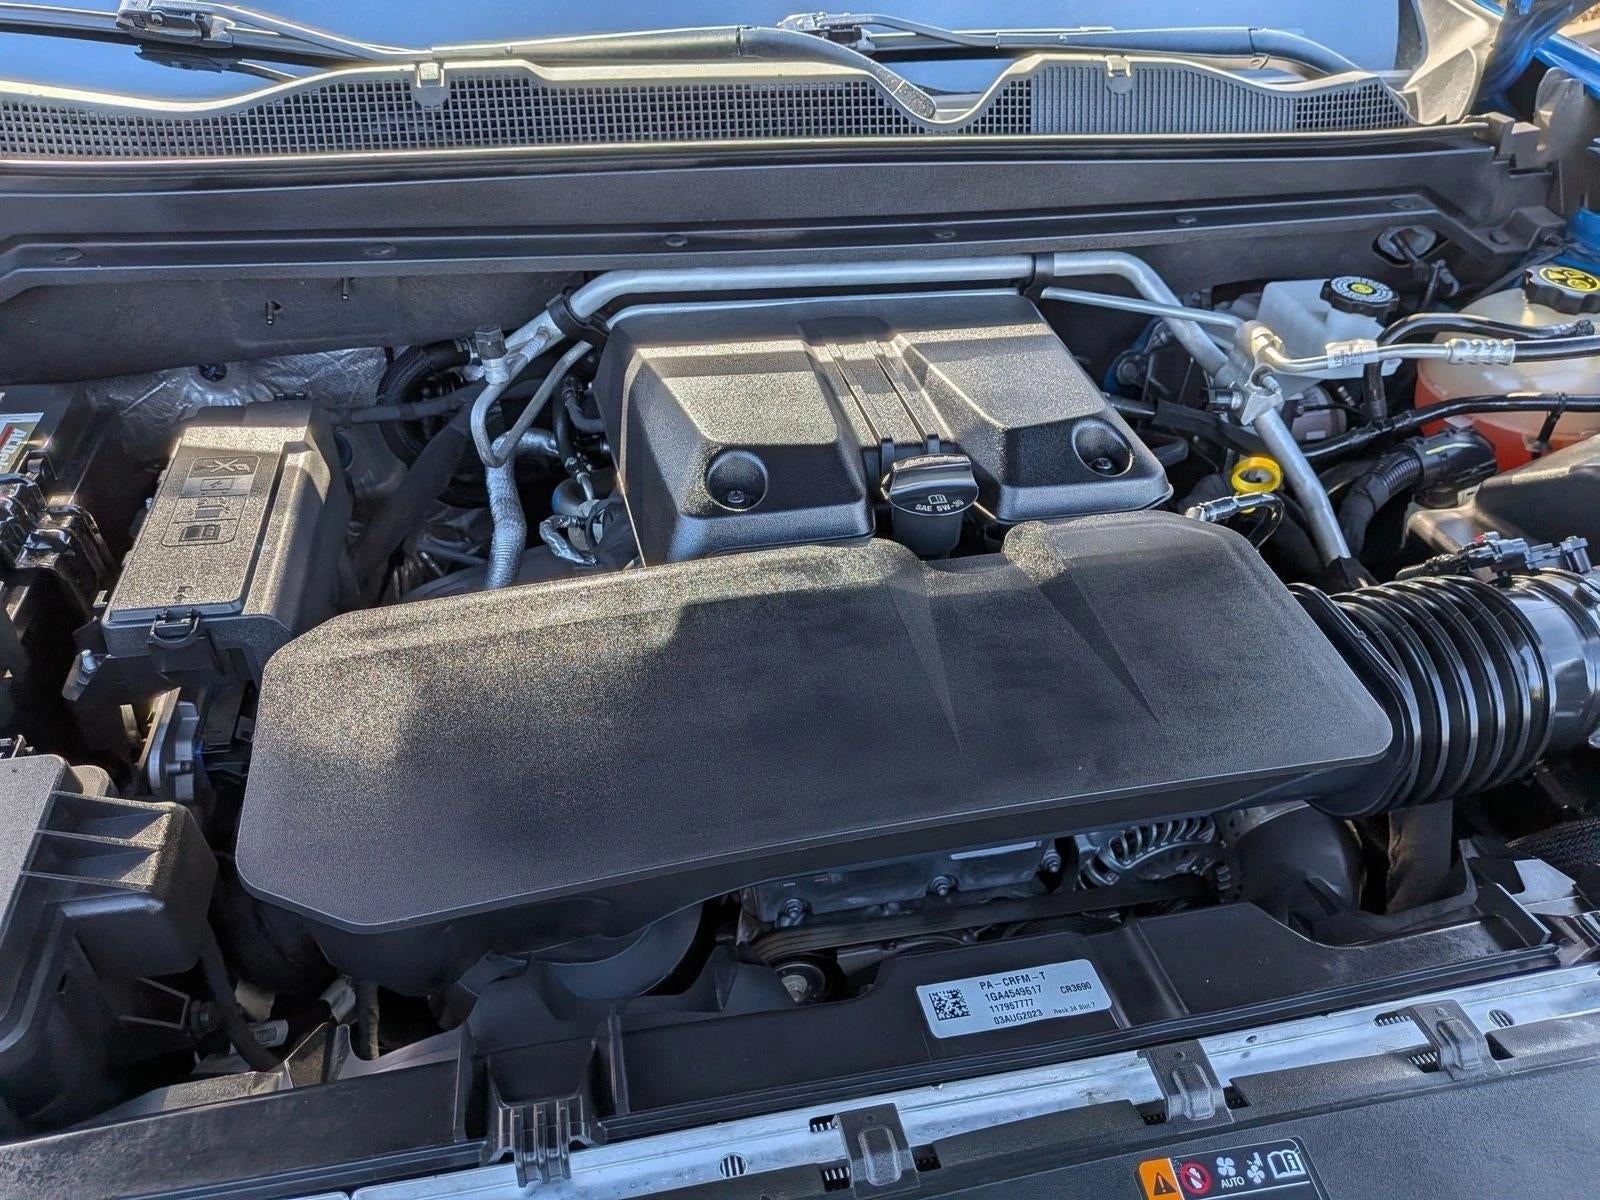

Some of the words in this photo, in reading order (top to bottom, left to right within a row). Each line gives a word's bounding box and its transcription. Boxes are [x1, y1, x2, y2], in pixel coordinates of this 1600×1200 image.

[0, 428, 27, 470] ACDel
[915, 503, 933, 512] SAE
[936, 499, 964, 512] 5W-30
[984, 984, 1042, 1002] 1GA4549617
[1059, 981, 1092, 995] CR3690
[989, 998, 1034, 1013] 117957777
[993, 1009, 1043, 1025] 03AUG2023
[1221, 1176, 1245, 1189] AUTO
